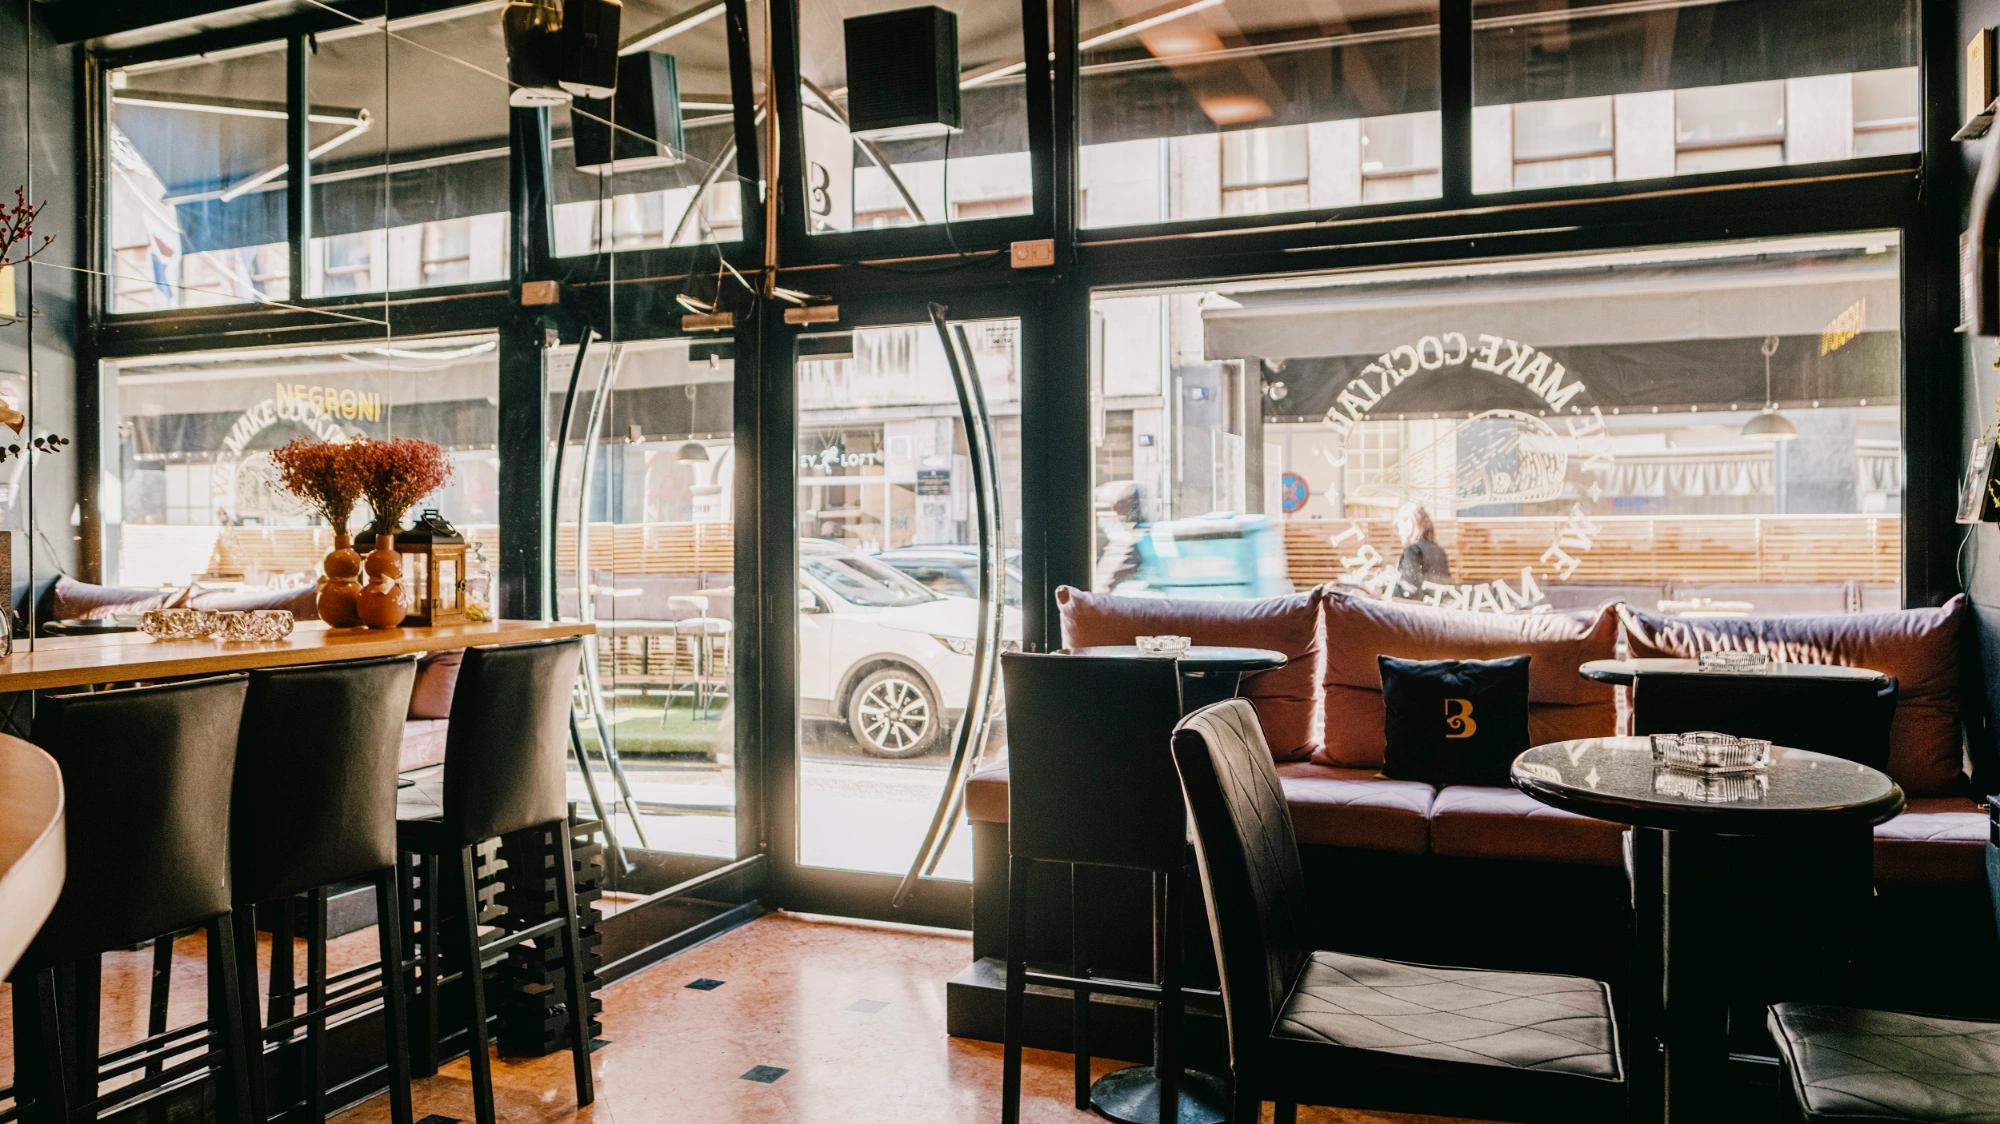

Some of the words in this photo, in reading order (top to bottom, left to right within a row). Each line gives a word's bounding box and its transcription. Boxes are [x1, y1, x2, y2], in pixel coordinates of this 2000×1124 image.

[275, 382, 381, 423] NEGRONI
[223, 398, 278, 457] MAKE
[1444, 698, 1477, 739] B
